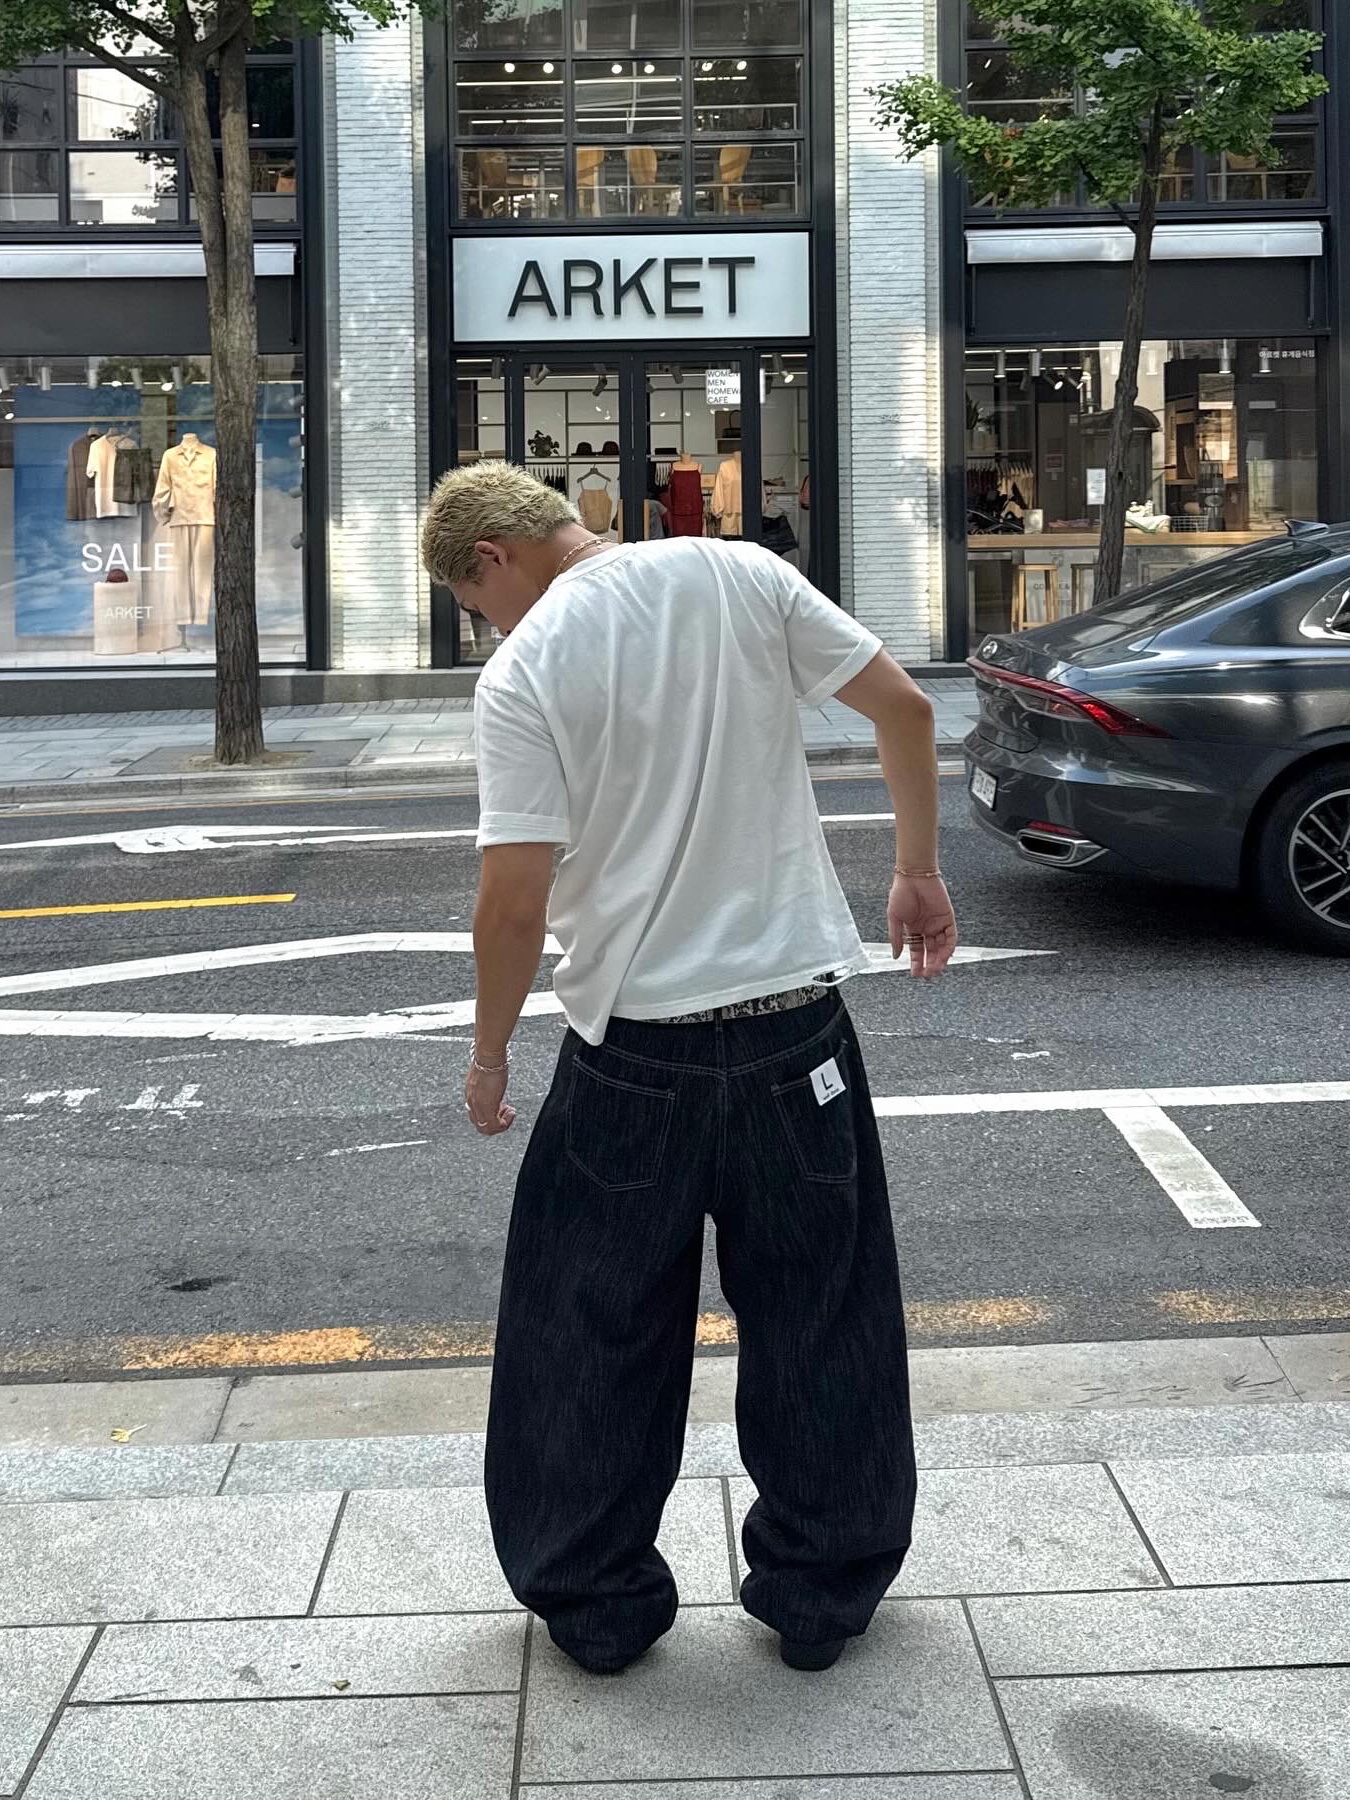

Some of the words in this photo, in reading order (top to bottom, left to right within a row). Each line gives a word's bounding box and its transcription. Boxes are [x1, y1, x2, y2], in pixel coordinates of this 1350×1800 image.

[507, 256, 756, 318] ARKET
[707, 387, 740, 395] HOMEW
[81, 542, 177, 573] SALE
[104, 606, 154, 620] ARKET
[820, 1072, 834, 1091] L
